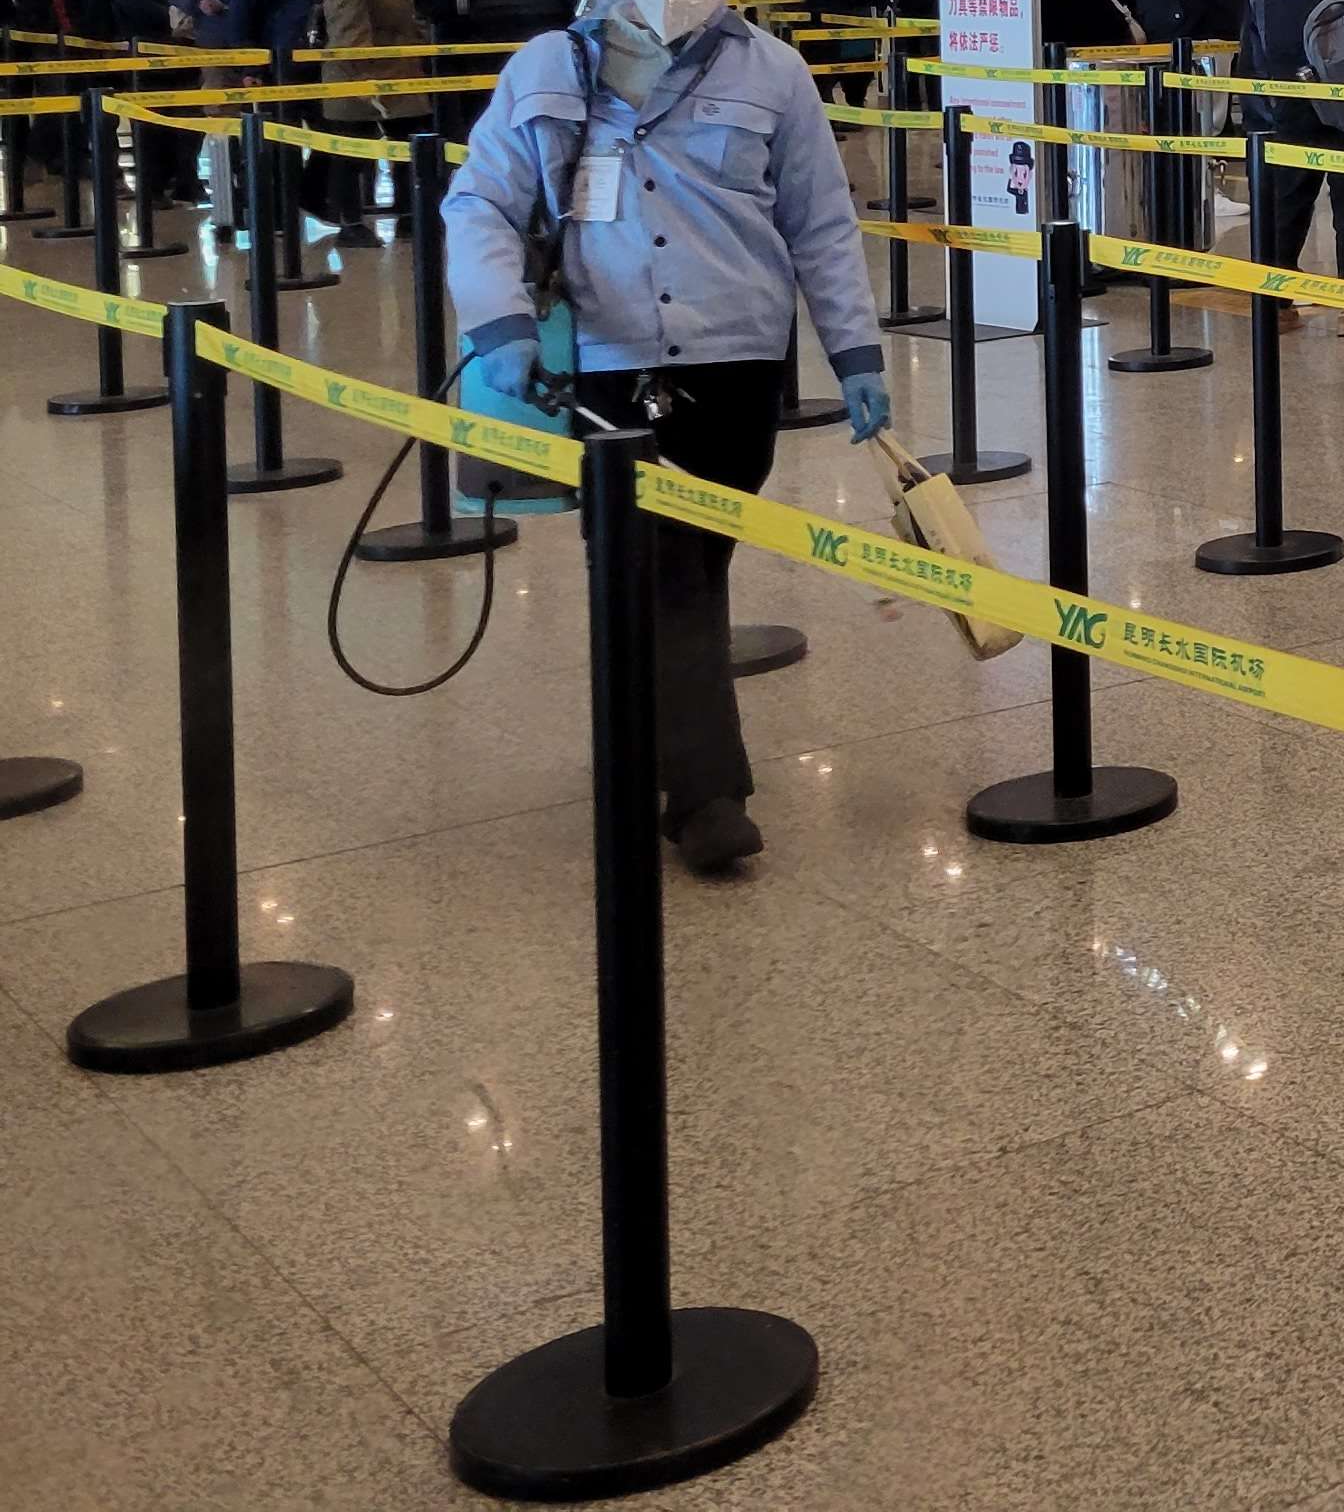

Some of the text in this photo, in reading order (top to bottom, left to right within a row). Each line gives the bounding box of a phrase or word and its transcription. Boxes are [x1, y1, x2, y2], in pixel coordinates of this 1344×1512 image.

[1123, 622, 1265, 680] 昆明长水国际机场
